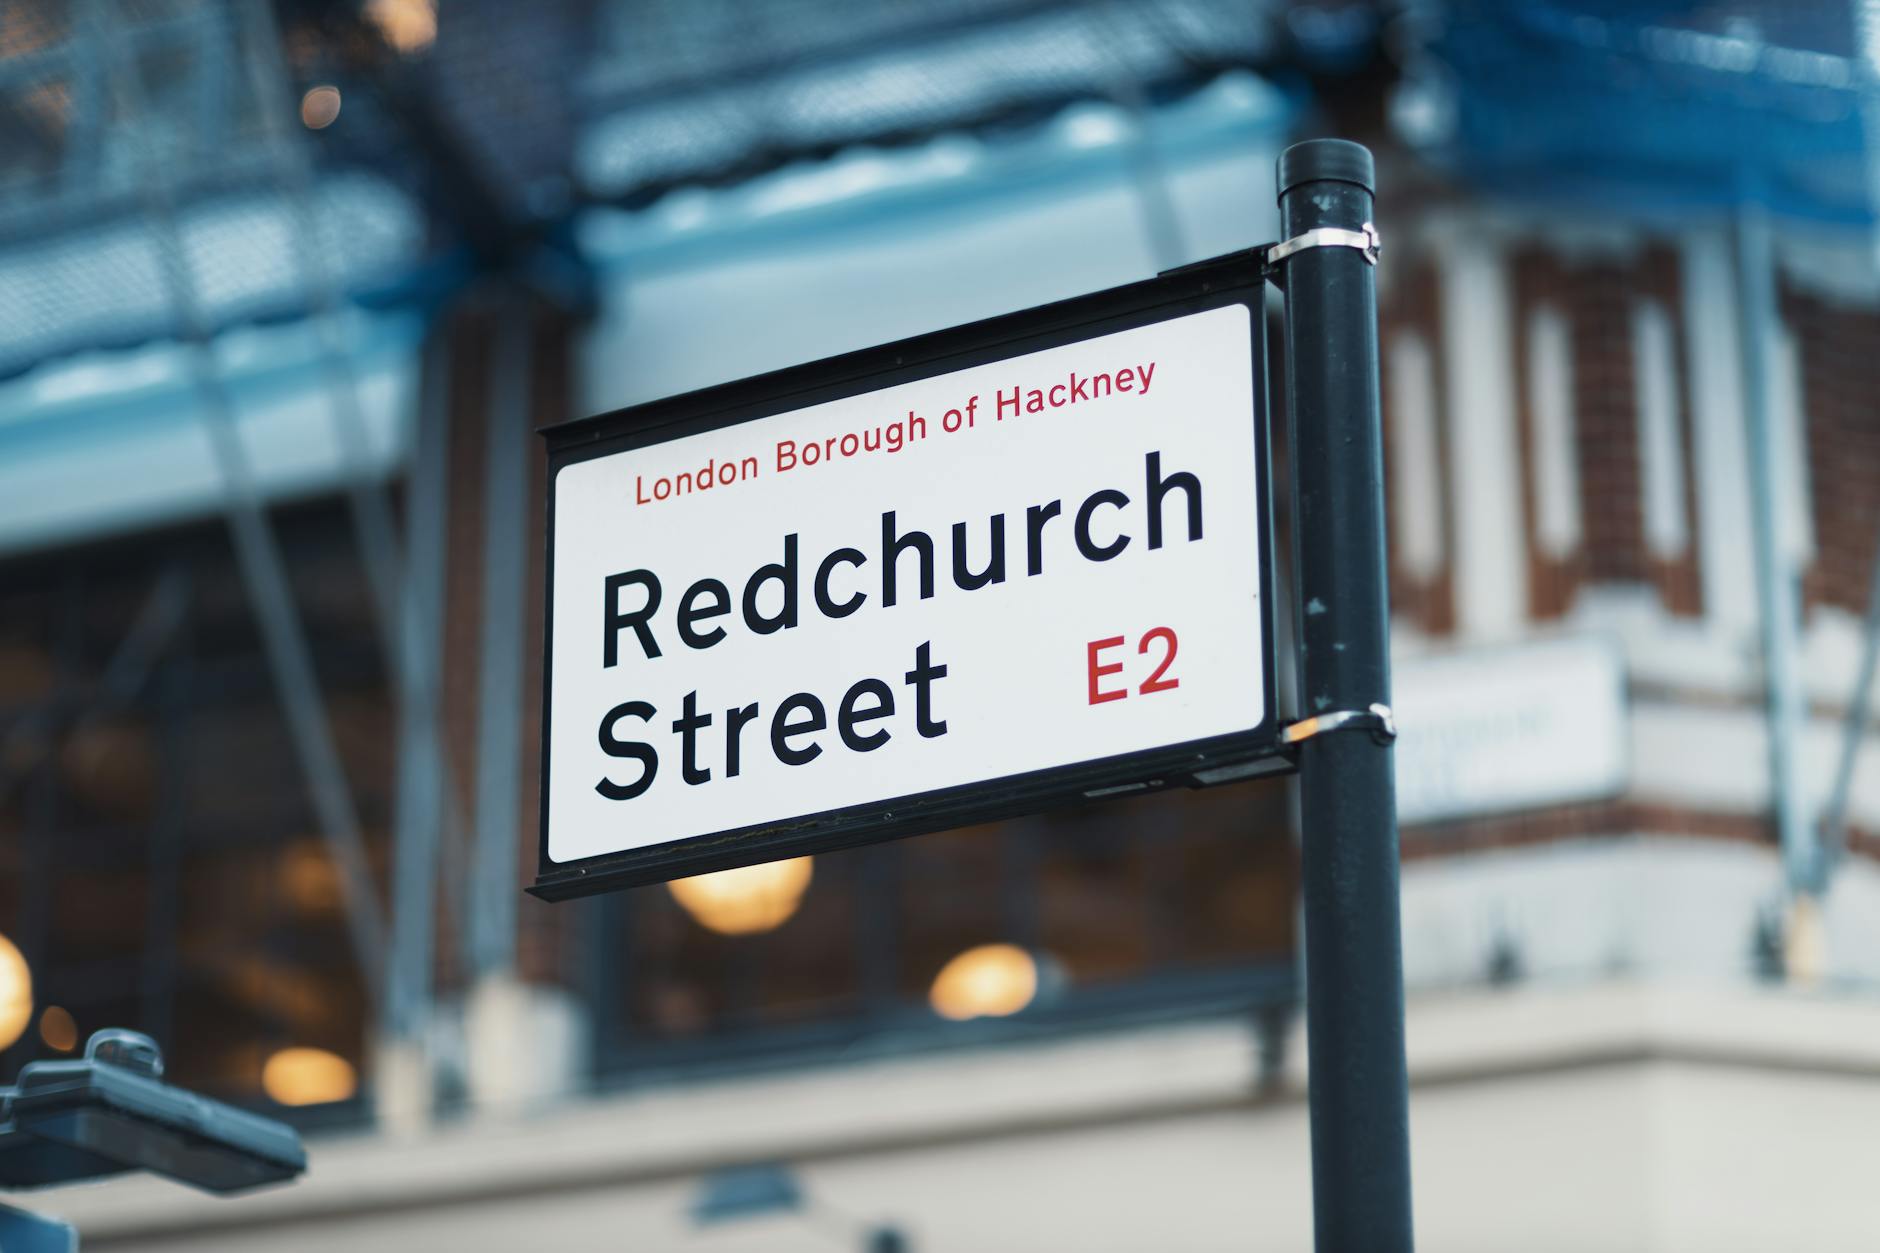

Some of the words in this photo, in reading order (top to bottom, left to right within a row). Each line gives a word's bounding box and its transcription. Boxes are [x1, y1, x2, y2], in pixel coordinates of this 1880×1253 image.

[635, 456, 759, 506] London
[776, 410, 928, 474] Borough
[942, 394, 980, 433] of
[996, 361, 1157, 422] Hackney
[603, 450, 1204, 669] Redchurch
[594, 640, 948, 801] Street
[1087, 626, 1180, 706] E2
